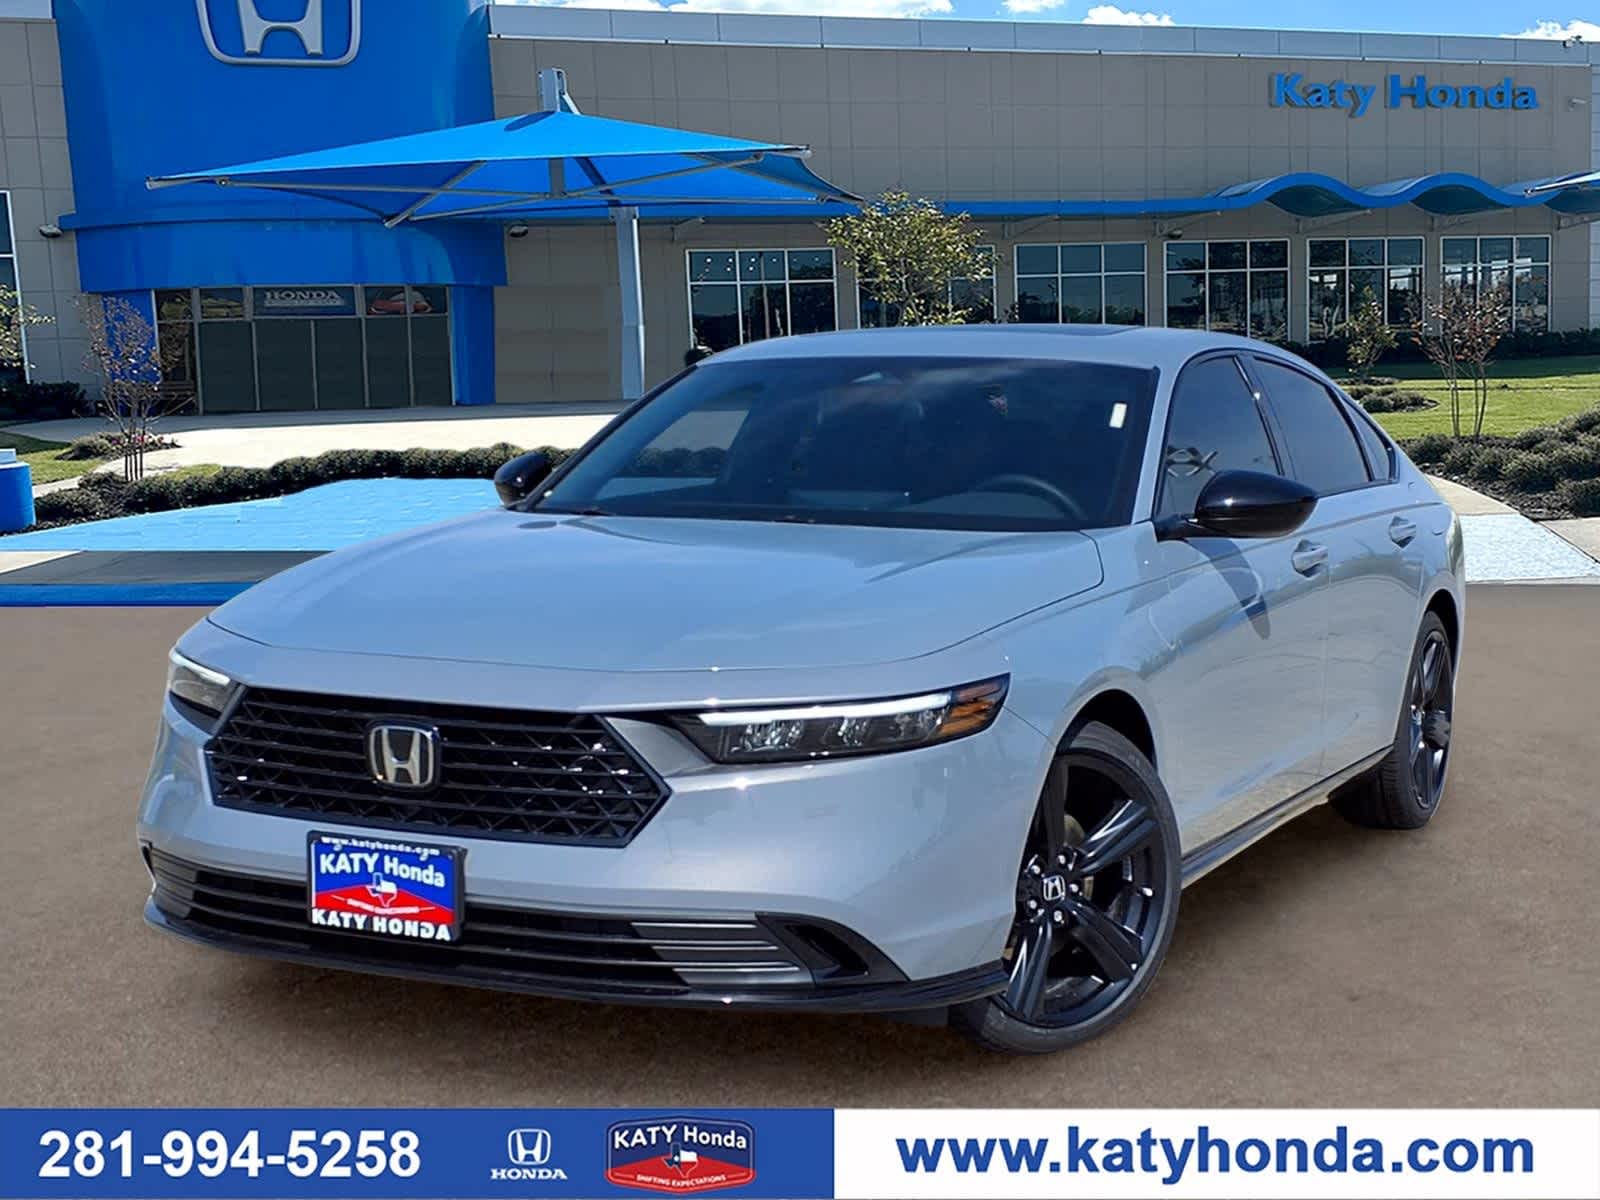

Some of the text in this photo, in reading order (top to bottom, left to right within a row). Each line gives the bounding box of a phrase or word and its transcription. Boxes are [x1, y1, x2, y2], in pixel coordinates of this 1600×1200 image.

[1271, 73, 1540, 117] Katy Honda
[264, 290, 341, 300] HONDA
[321, 836, 441, 861] www.katyhonda.com
[319, 853, 446, 888] KATY Honda
[311, 908, 451, 941] KATY HONDA
